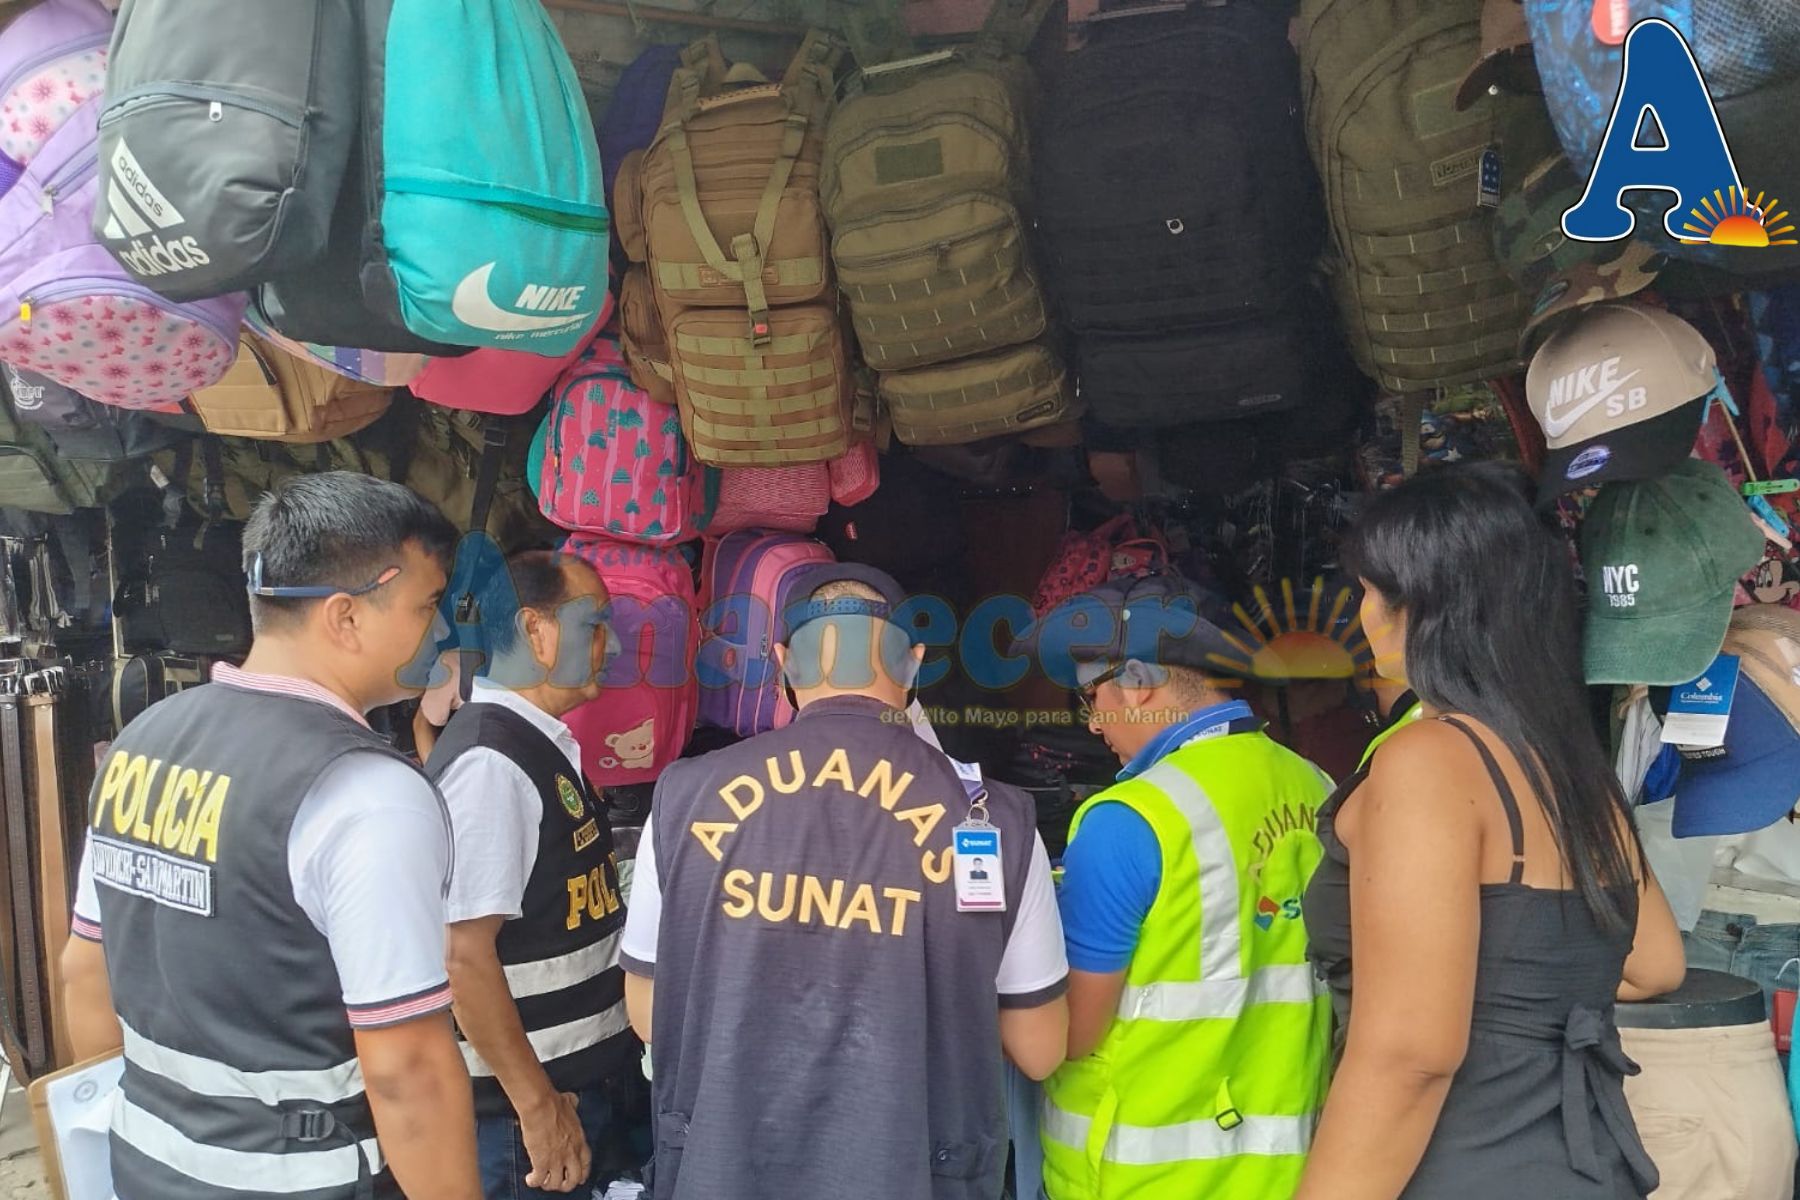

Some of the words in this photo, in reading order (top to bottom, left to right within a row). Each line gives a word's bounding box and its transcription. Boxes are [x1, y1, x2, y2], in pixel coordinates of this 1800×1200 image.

[118, 155, 164, 218] adidas
[118, 233, 211, 277] adidas
[514, 283, 587, 312] NIKE
[1550, 356, 1621, 408] NIKE
[1605, 386, 1648, 418] SB
[1602, 563, 1640, 594] NYC
[1608, 593, 1636, 608] 1985
[690, 748, 954, 884] ADUANAS
[722, 868, 922, 937] SUNAT
